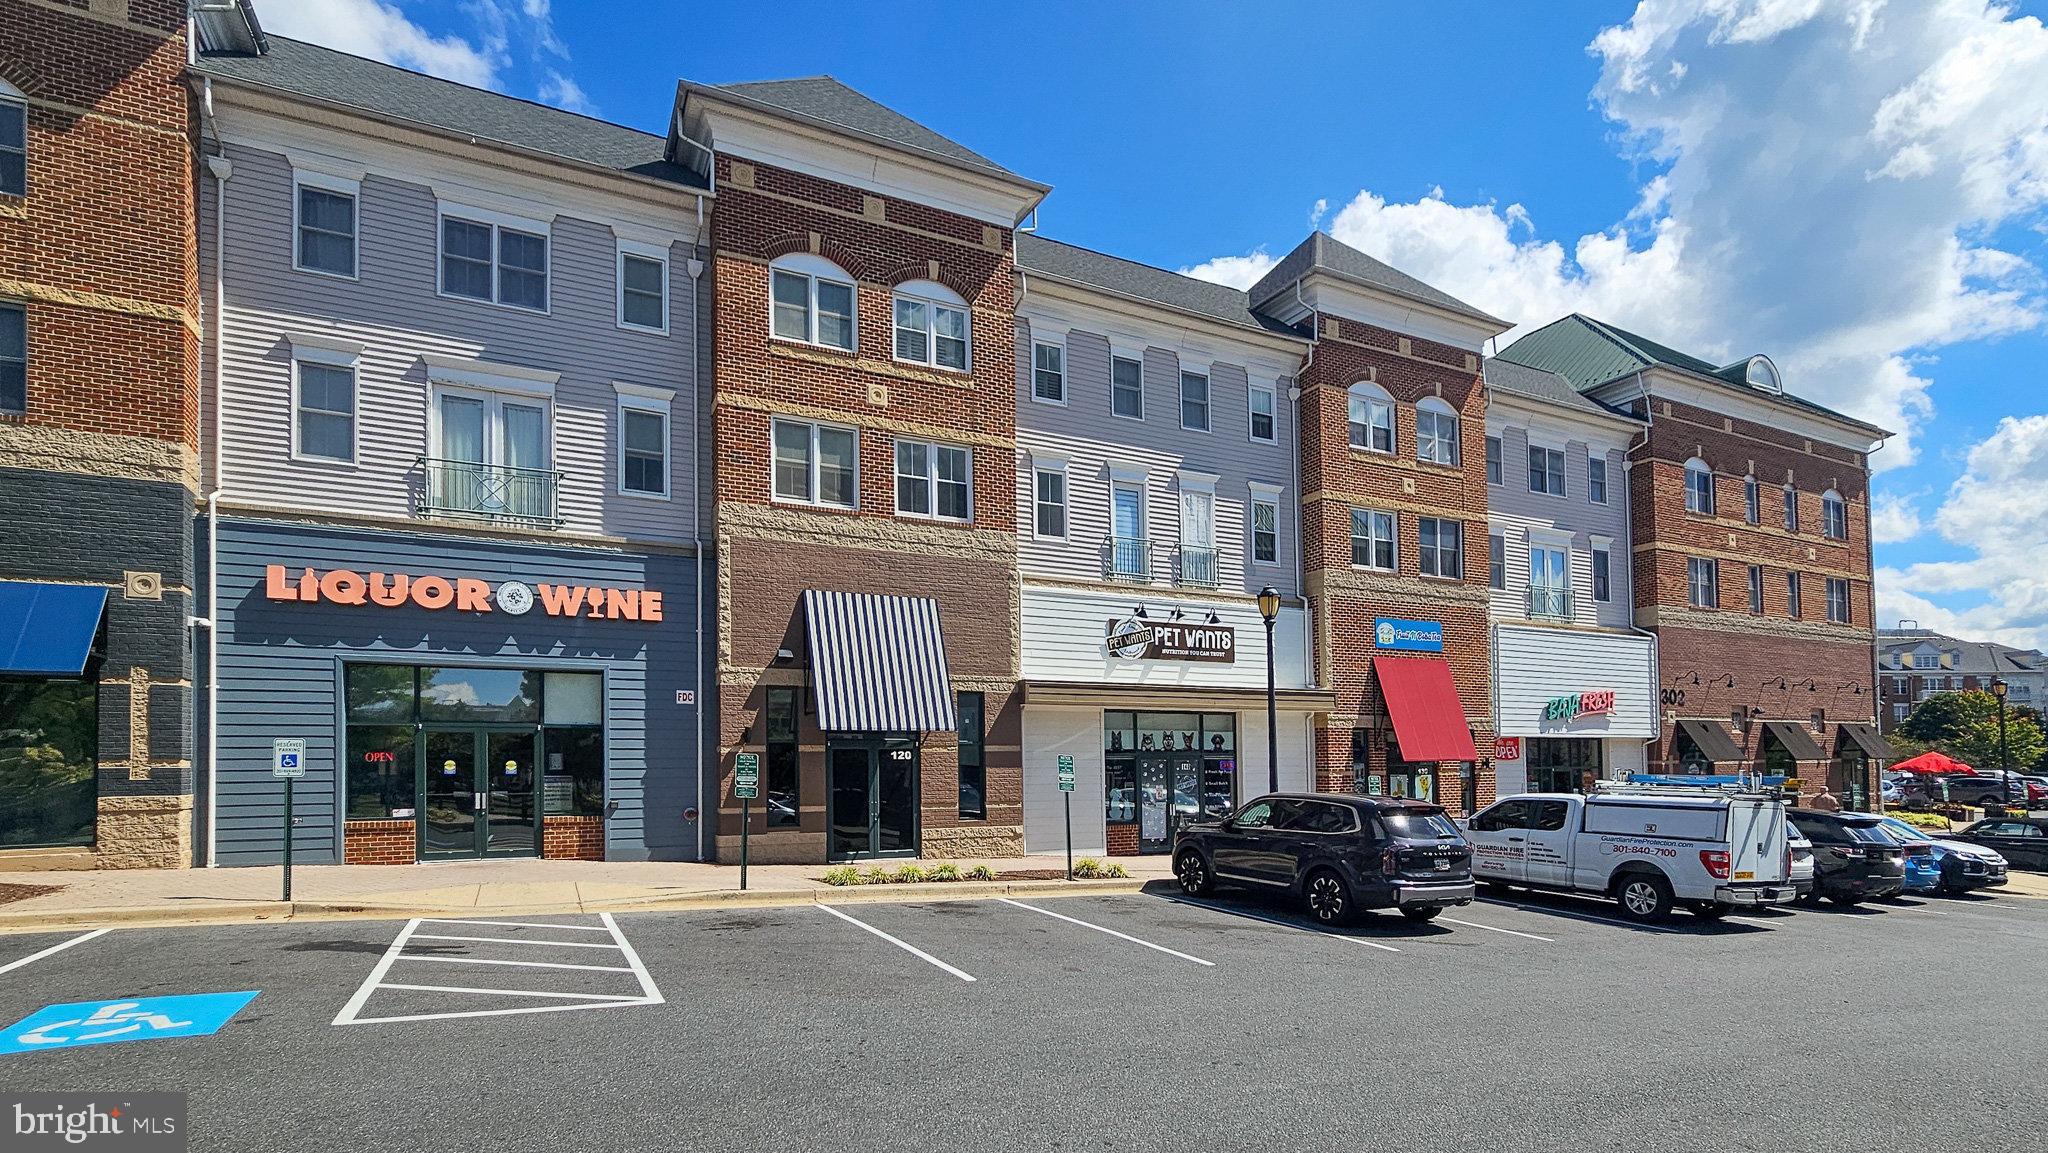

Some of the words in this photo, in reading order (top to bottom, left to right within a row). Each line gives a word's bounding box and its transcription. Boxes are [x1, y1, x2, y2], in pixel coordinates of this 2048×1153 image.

[266, 564, 493, 612] LIQUOR
[537, 584, 663, 621] WINE
[1108, 637, 1123, 649] PET
[1125, 630, 1152, 646] WANTS
[1155, 626, 1181, 647] PET
[1184, 628, 1232, 650] WANTS
[1161, 648, 1189, 656] NUTRITION
[677, 692, 693, 702] FDC
[1661, 688, 1686, 706] 302
[1547, 692, 1579, 720] BAJA
[1580, 689, 1615, 713] FRESH
[364, 752, 394, 763] OPEN
[890, 750, 912, 760] 120
[1495, 745, 1519, 759] OPEN
[1476, 844, 1508, 852] GUARDIAN
[1600, 835, 1694, 849] GuardianFireProtection.com
[1612, 844, 1677, 858] 301-840-7100
